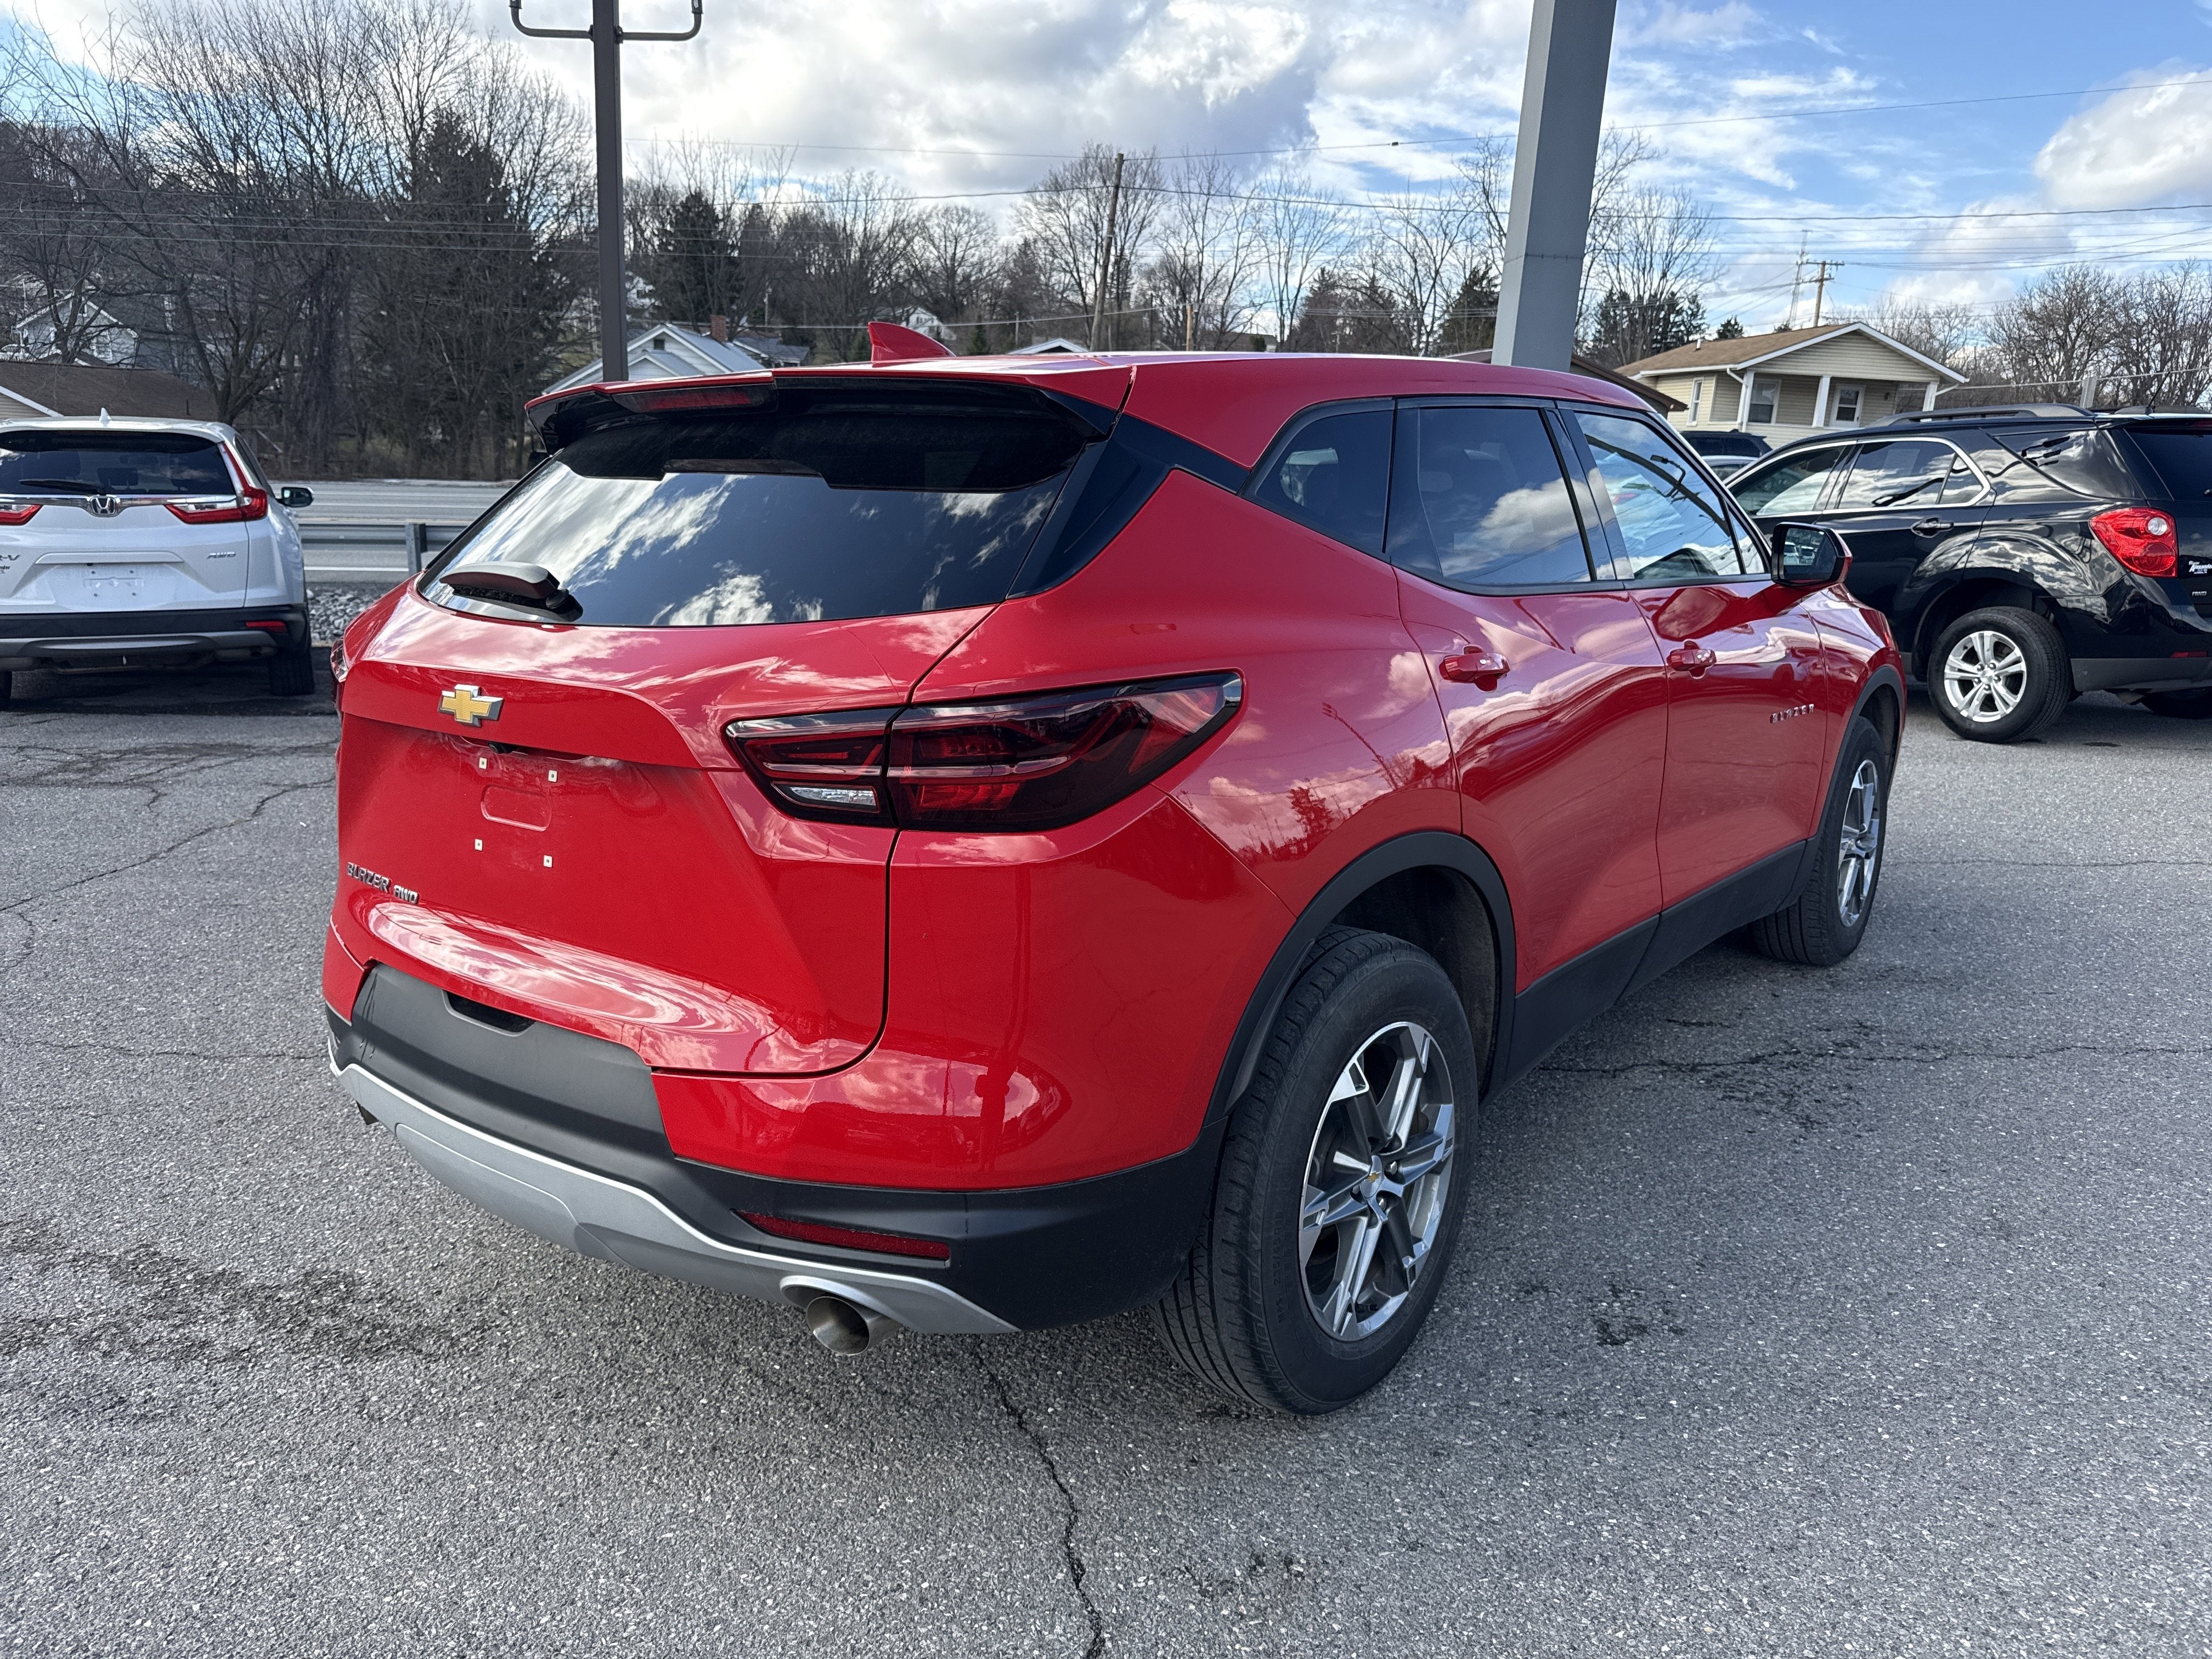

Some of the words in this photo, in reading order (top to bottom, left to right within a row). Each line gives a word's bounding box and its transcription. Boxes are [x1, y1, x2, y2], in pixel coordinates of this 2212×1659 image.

[1770, 703, 1814, 724] BLAZER
[347, 862, 392, 893] BLAZER
[393, 884, 420, 905] AWD
